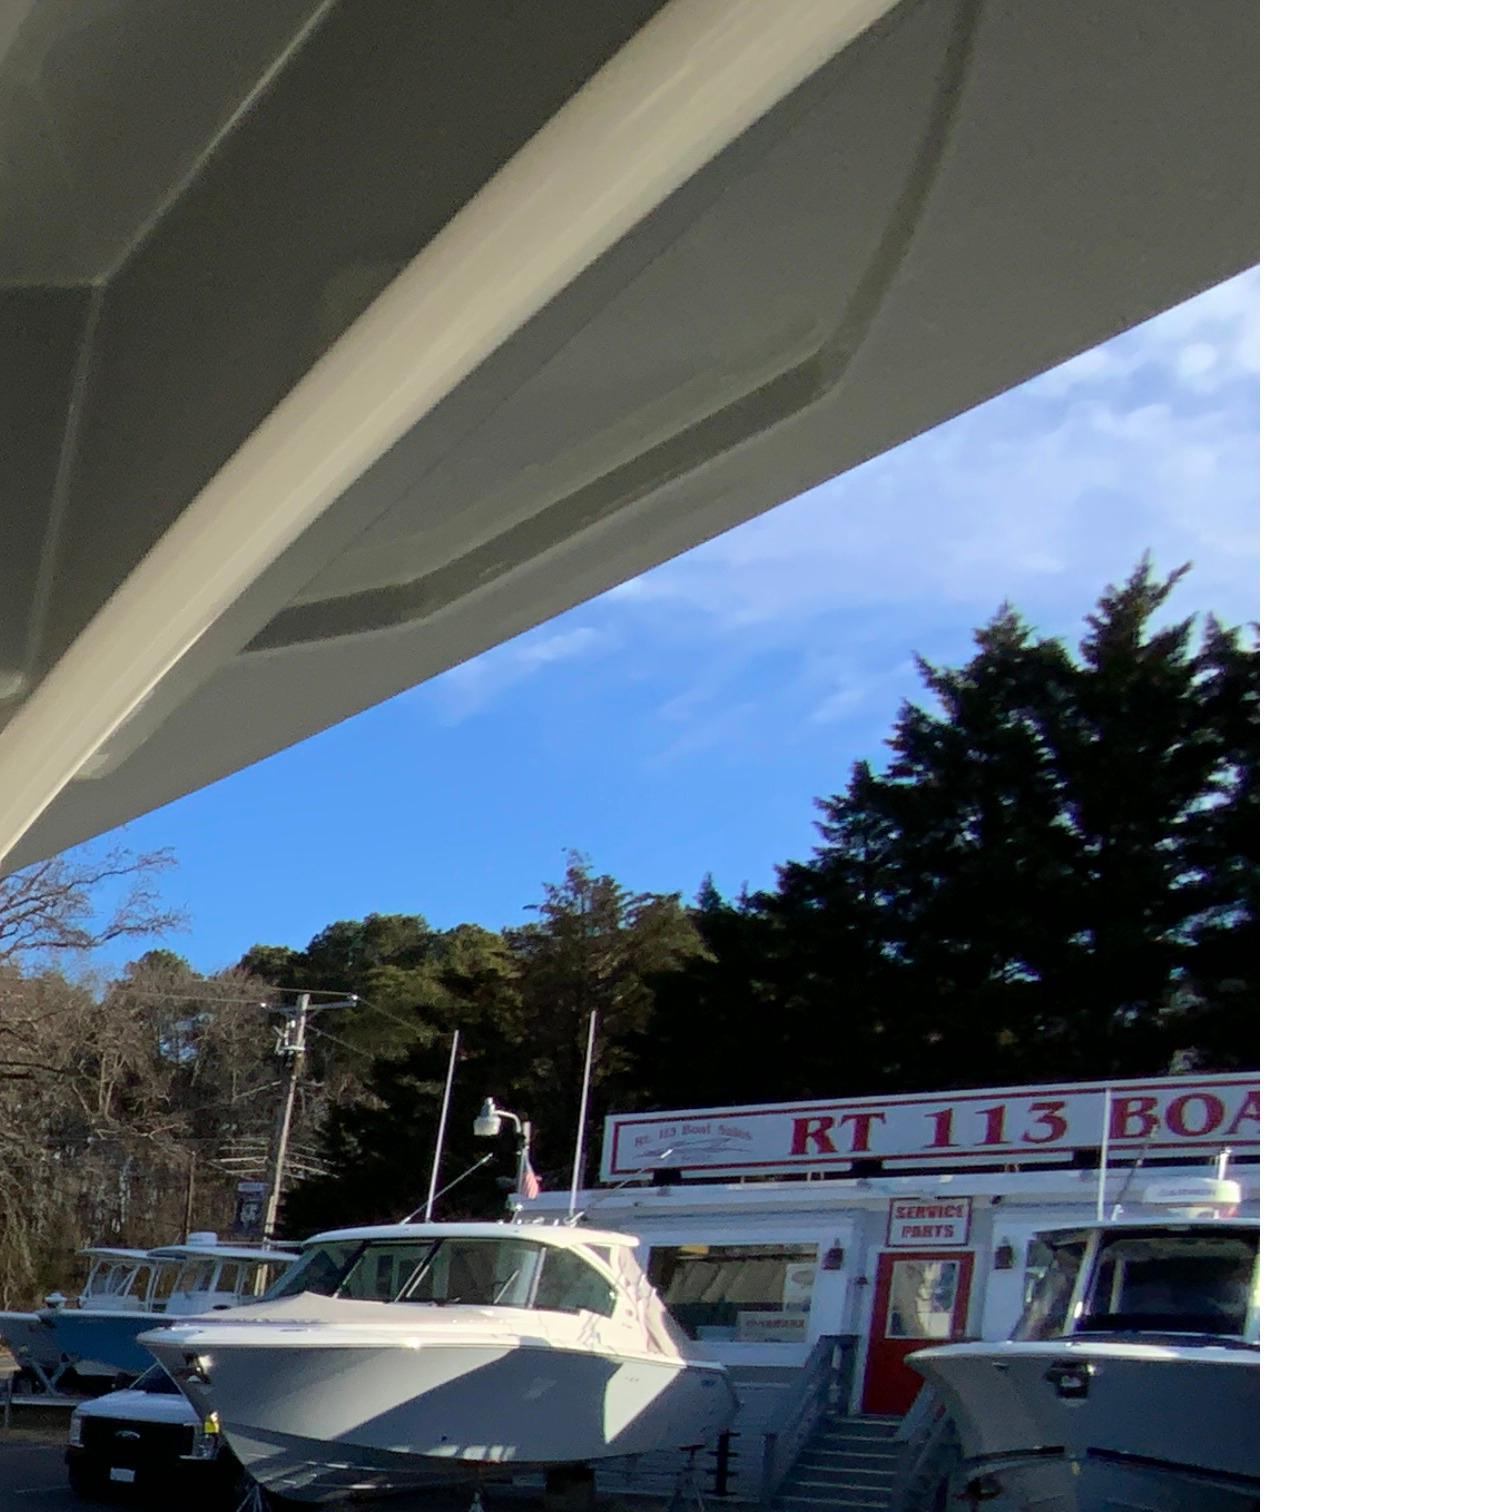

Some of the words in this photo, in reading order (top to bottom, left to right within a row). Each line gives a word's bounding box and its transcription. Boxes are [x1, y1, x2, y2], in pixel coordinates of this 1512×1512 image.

[789, 1112, 887, 1156] RT
[924, 1100, 1069, 1149] 113
[896, 1204, 964, 1219] SERVICE
[901, 1224, 955, 1238] PARTS
